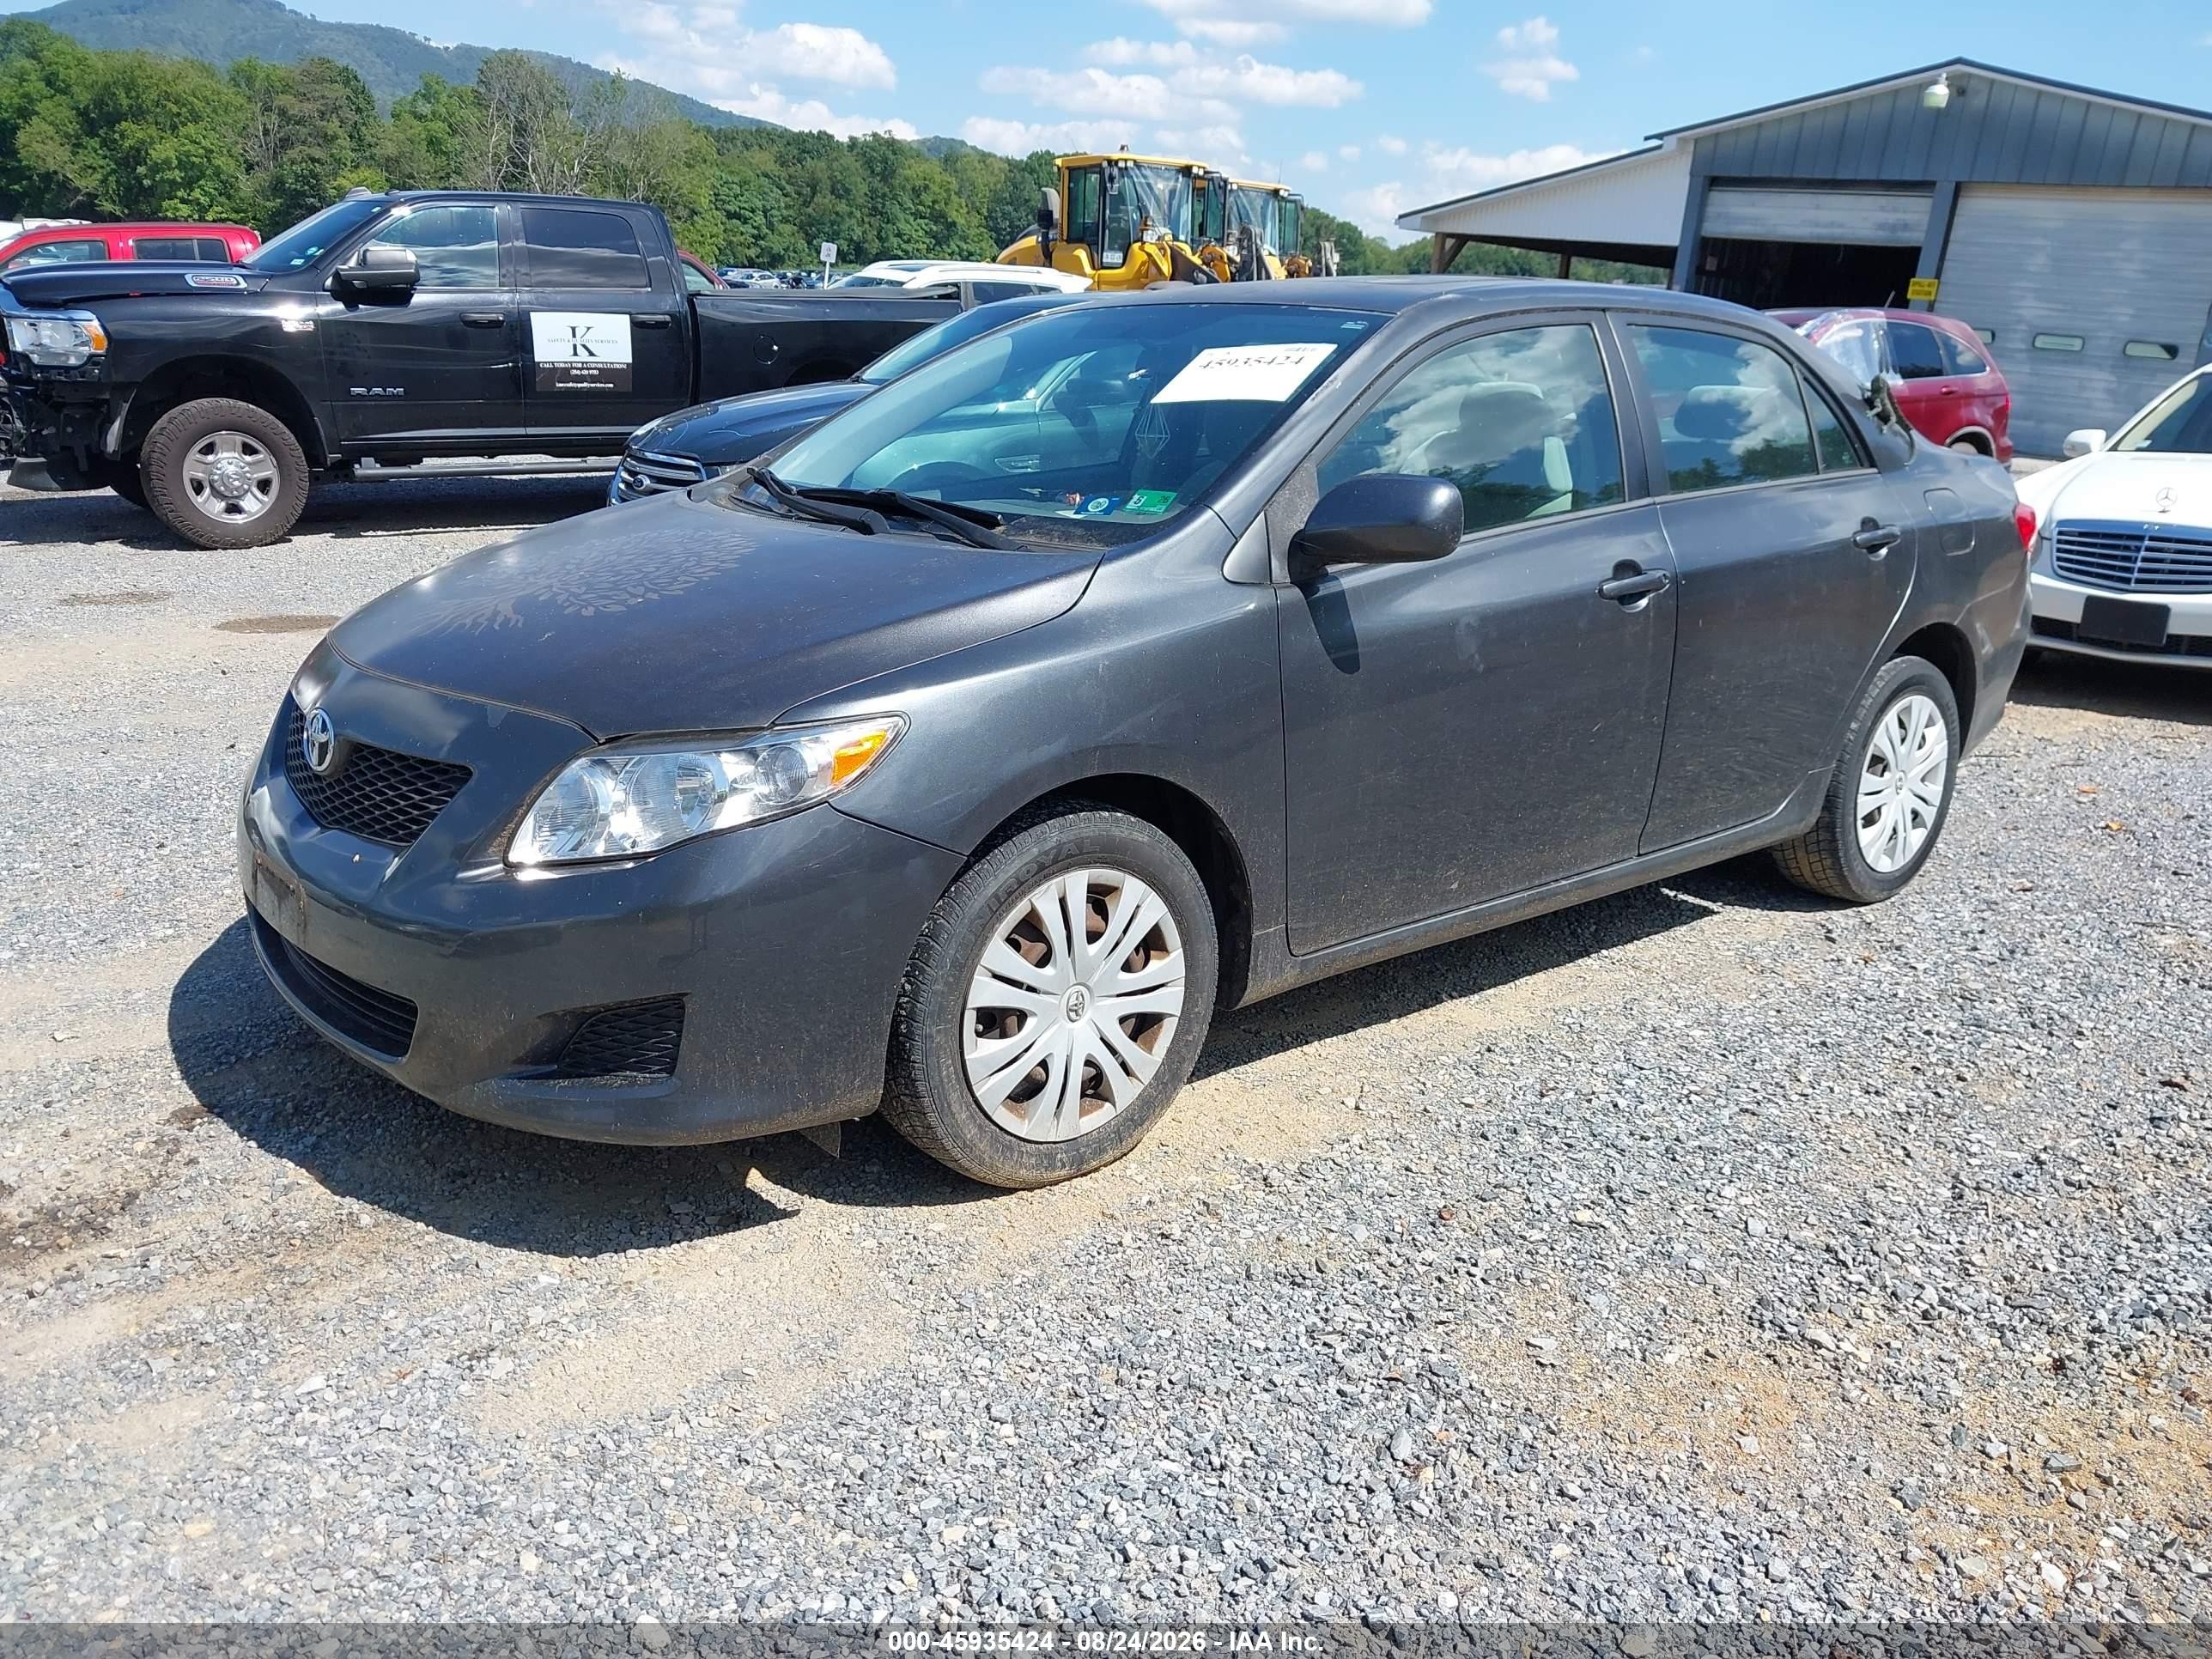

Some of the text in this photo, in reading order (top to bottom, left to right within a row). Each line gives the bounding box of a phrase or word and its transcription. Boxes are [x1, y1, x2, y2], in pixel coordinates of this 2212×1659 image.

[566, 325, 600, 357] K
[349, 387, 404, 396] RAM
[1133, 495, 1145, 505] 6
[956, 837, 1101, 958] NIROYAL
